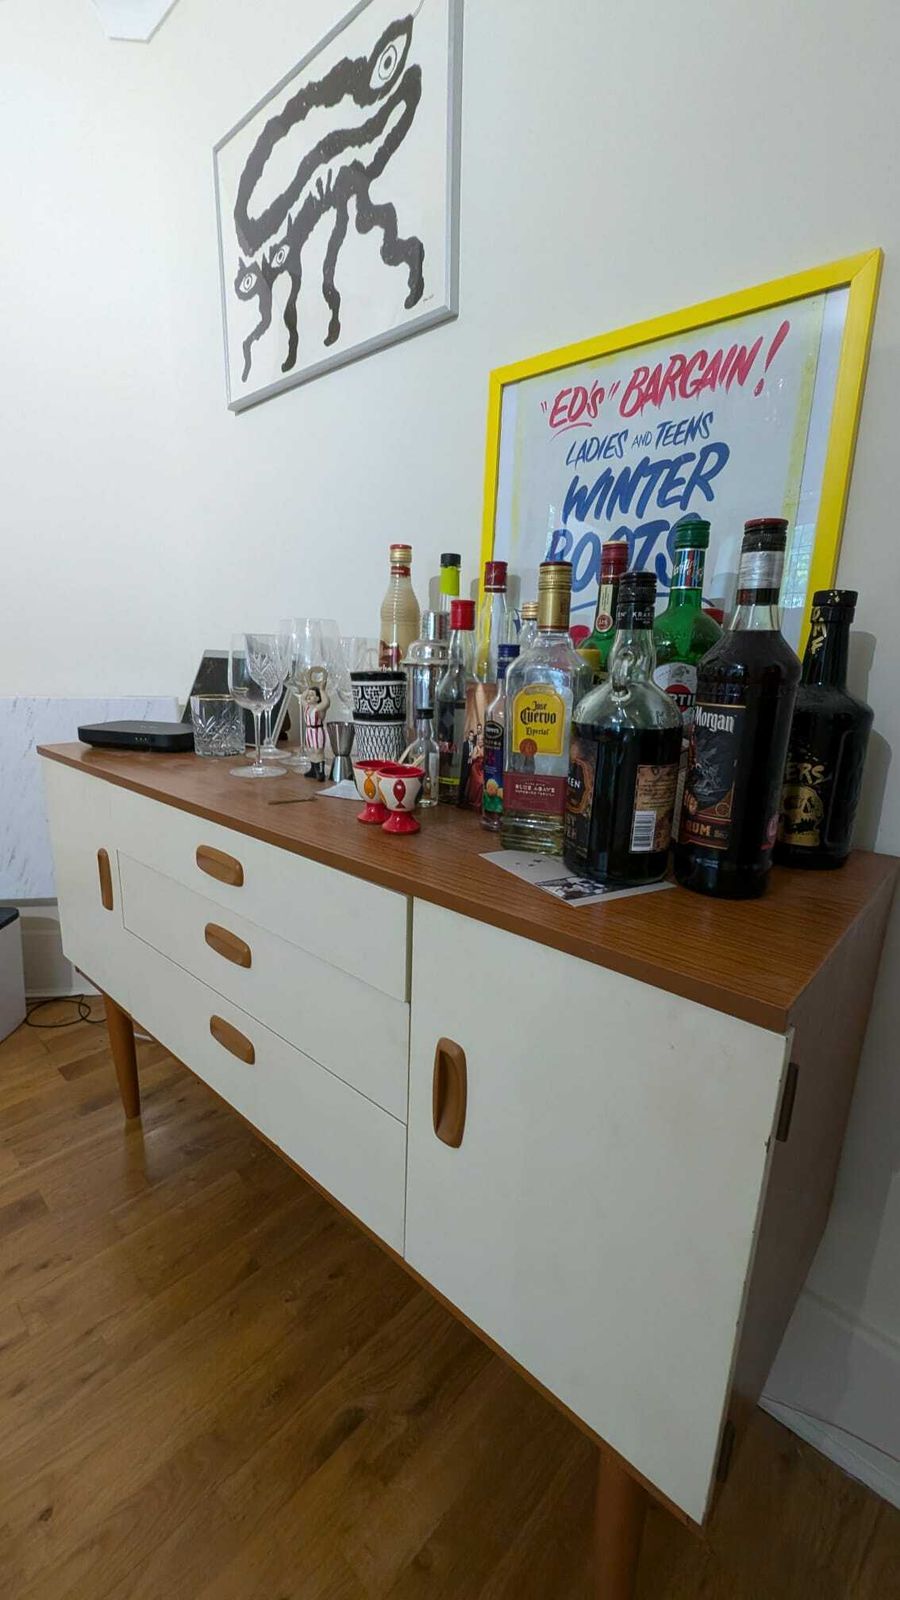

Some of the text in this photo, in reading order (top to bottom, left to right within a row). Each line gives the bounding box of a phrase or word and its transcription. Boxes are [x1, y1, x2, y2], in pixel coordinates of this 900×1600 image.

[619, 319, 790, 418] BARGAIN!
[565, 411, 714, 469] LADIES AND TEENS
[561, 441, 731, 525] WINTER
[520, 706, 557, 725] Cuervo
